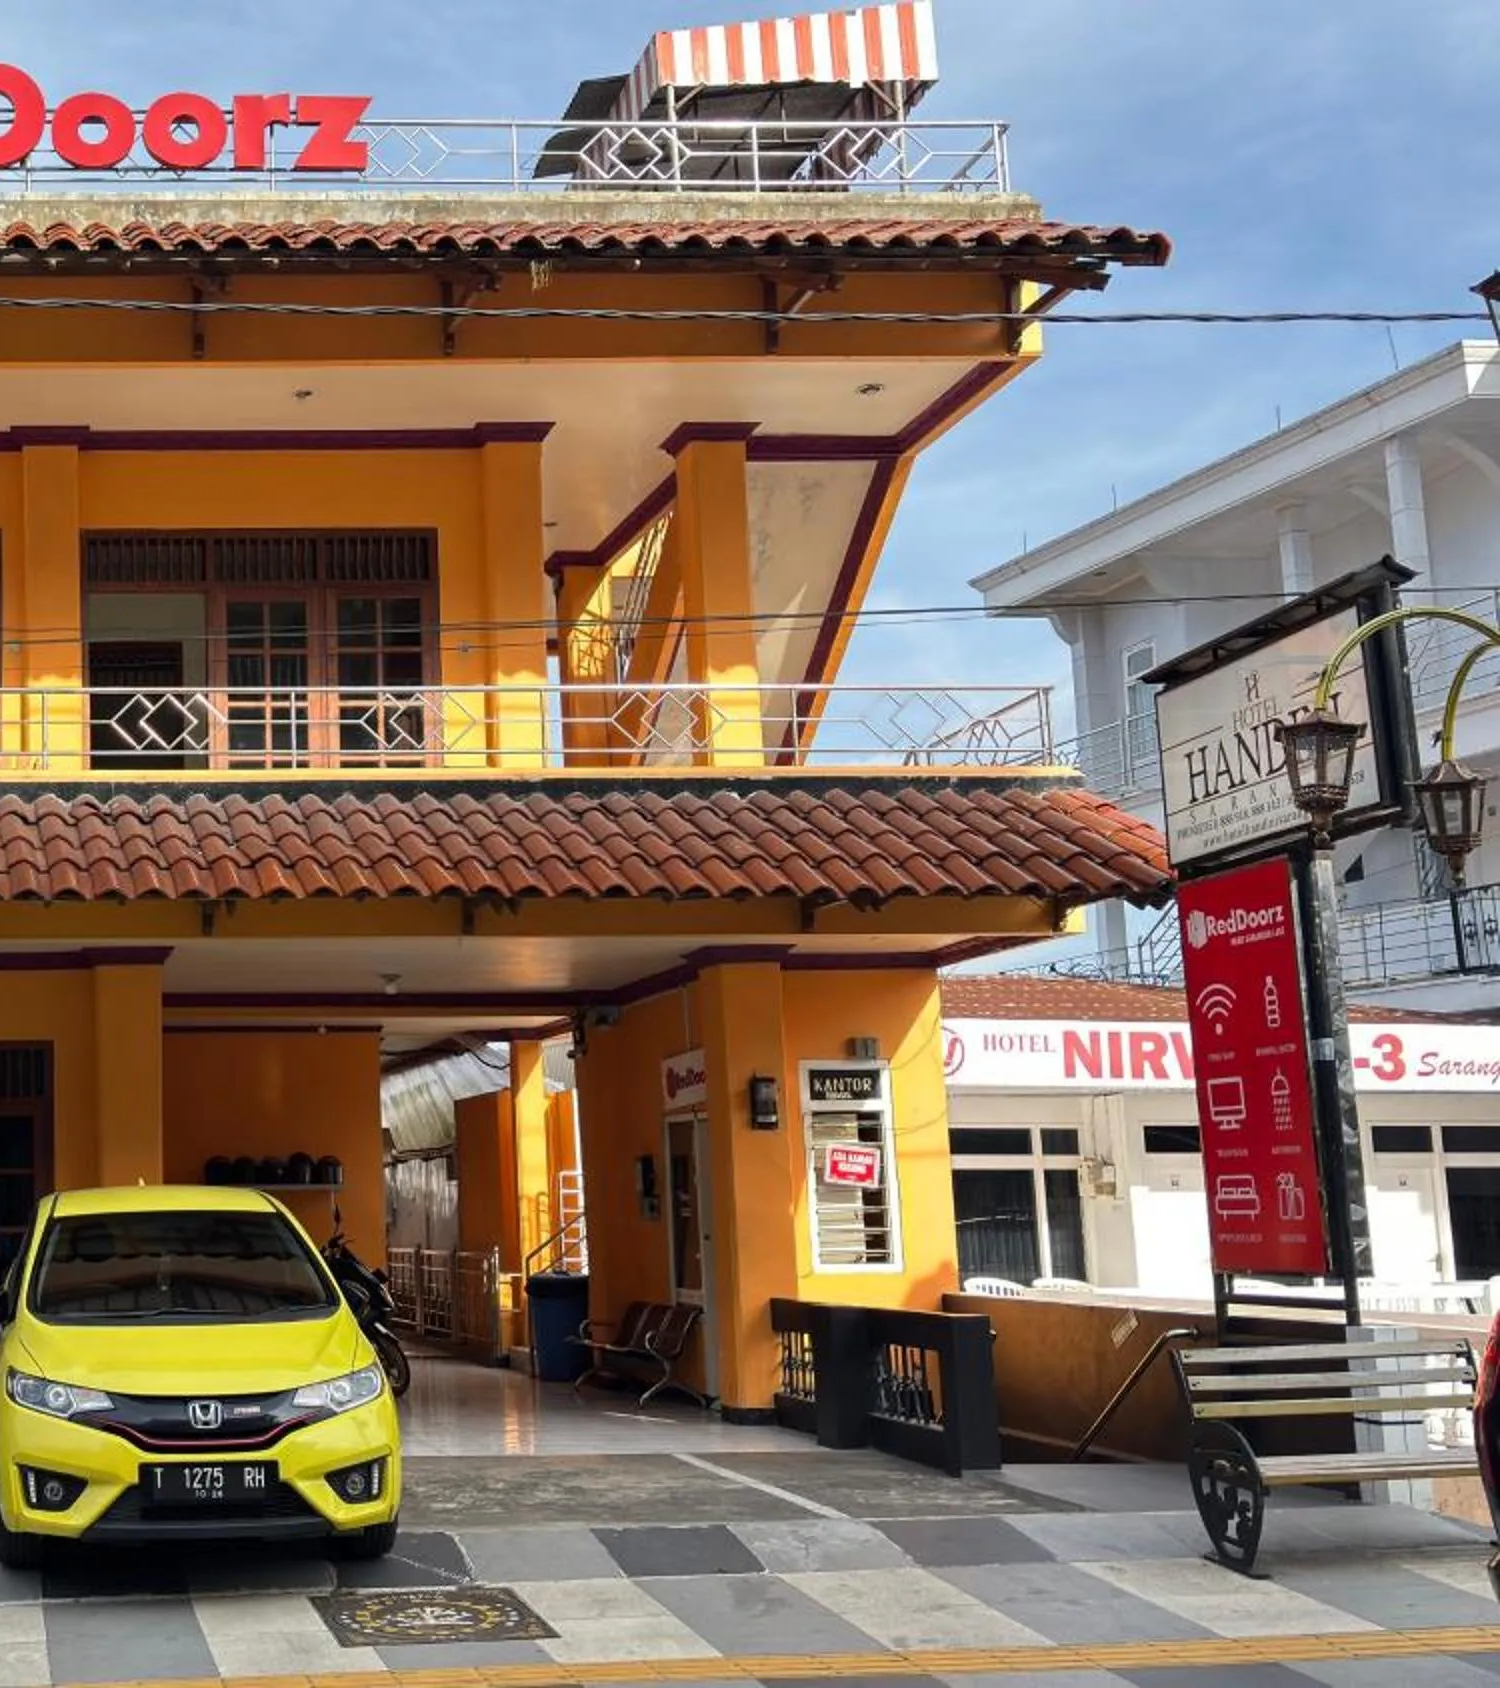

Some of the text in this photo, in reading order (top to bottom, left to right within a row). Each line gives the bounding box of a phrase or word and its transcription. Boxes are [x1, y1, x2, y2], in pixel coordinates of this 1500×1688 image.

[1232, 695, 1282, 734] HOTEL
[1205, 905, 1285, 938] RedDoorz
[983, 1033, 1056, 1053] HOTEL
[813, 1077, 873, 1092] KANTOR
[154, 1467, 265, 1489] T 1275 RH
